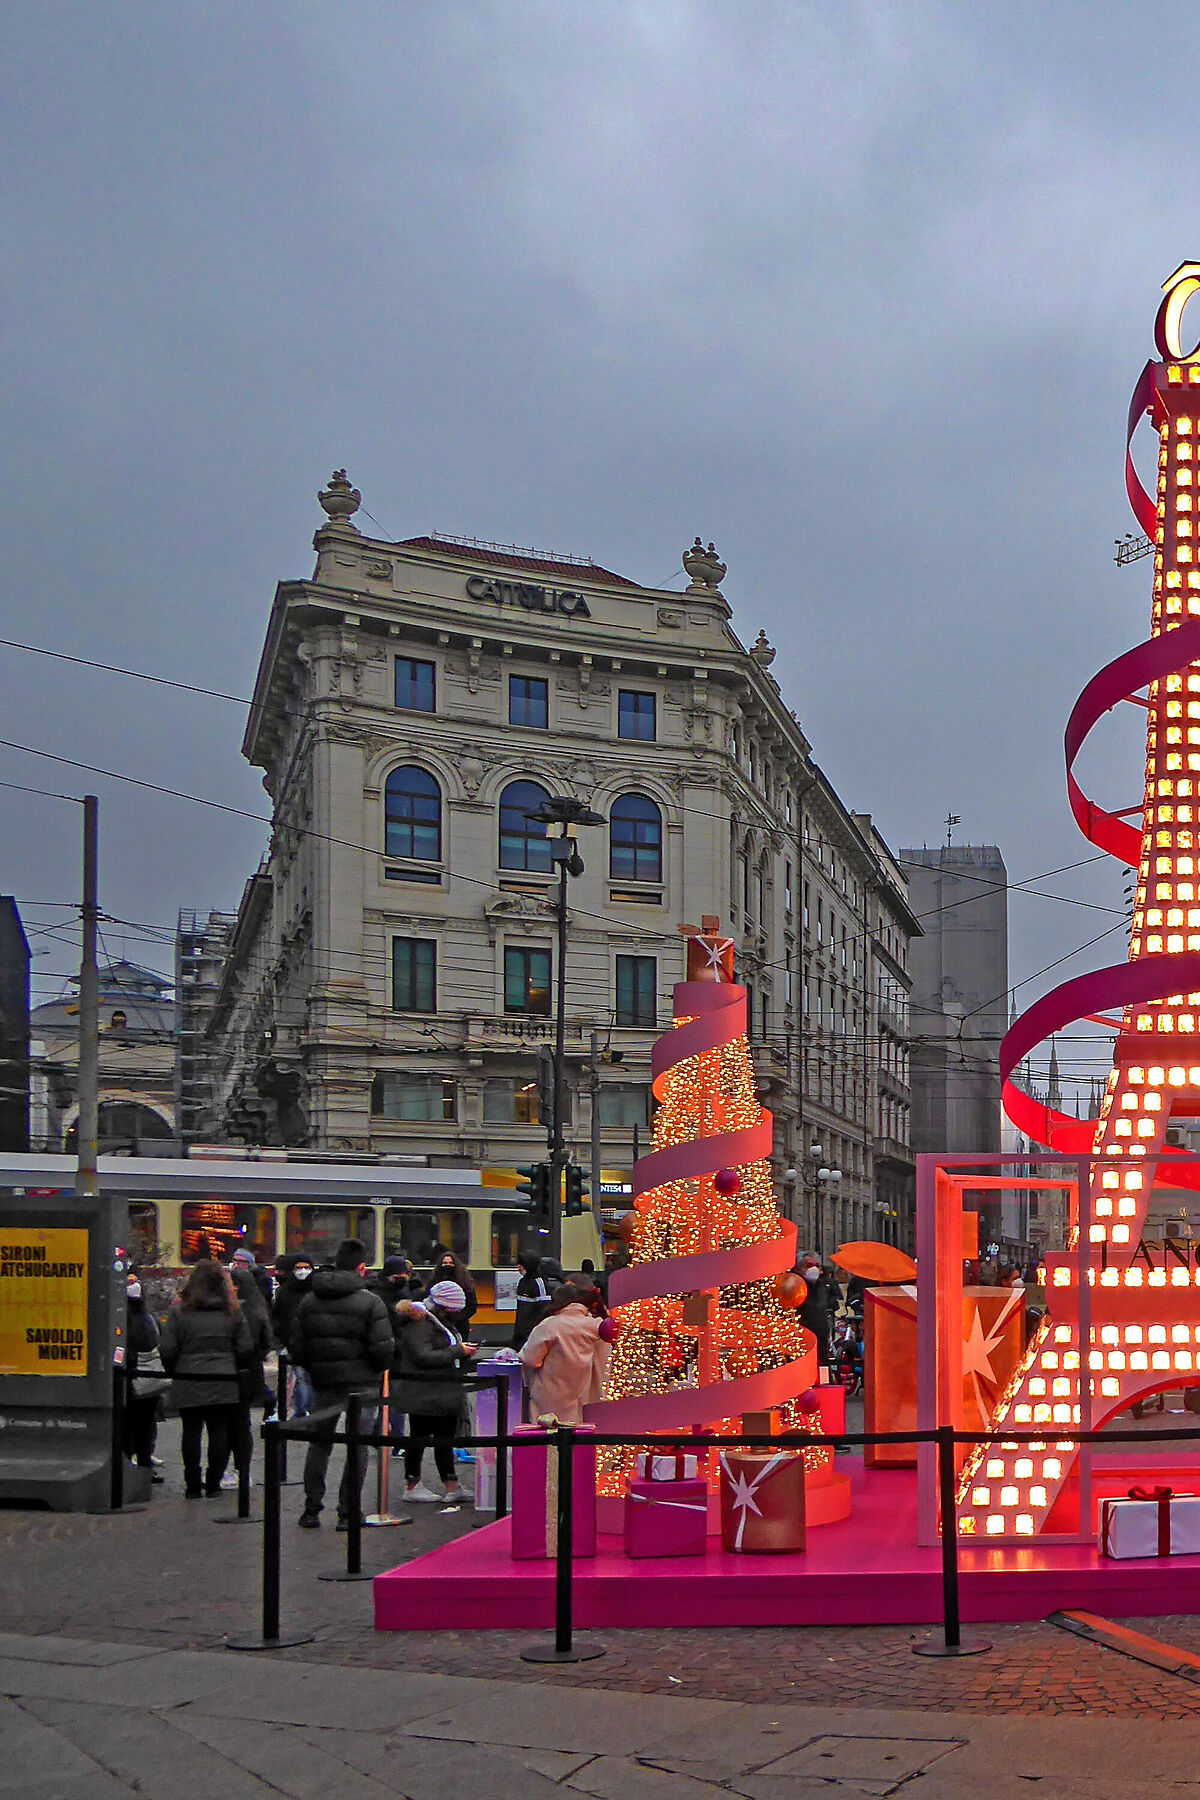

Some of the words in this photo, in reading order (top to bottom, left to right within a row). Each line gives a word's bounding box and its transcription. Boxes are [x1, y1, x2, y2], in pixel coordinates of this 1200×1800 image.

[600, 1184, 622, 1193] NTESA
[1, 1245, 47, 1261] SIRONI
[0, 1262, 85, 1278] ATCHUGARRY
[26, 1328, 84, 1344] SAVOLDO
[38, 1345, 83, 1360] MONET
